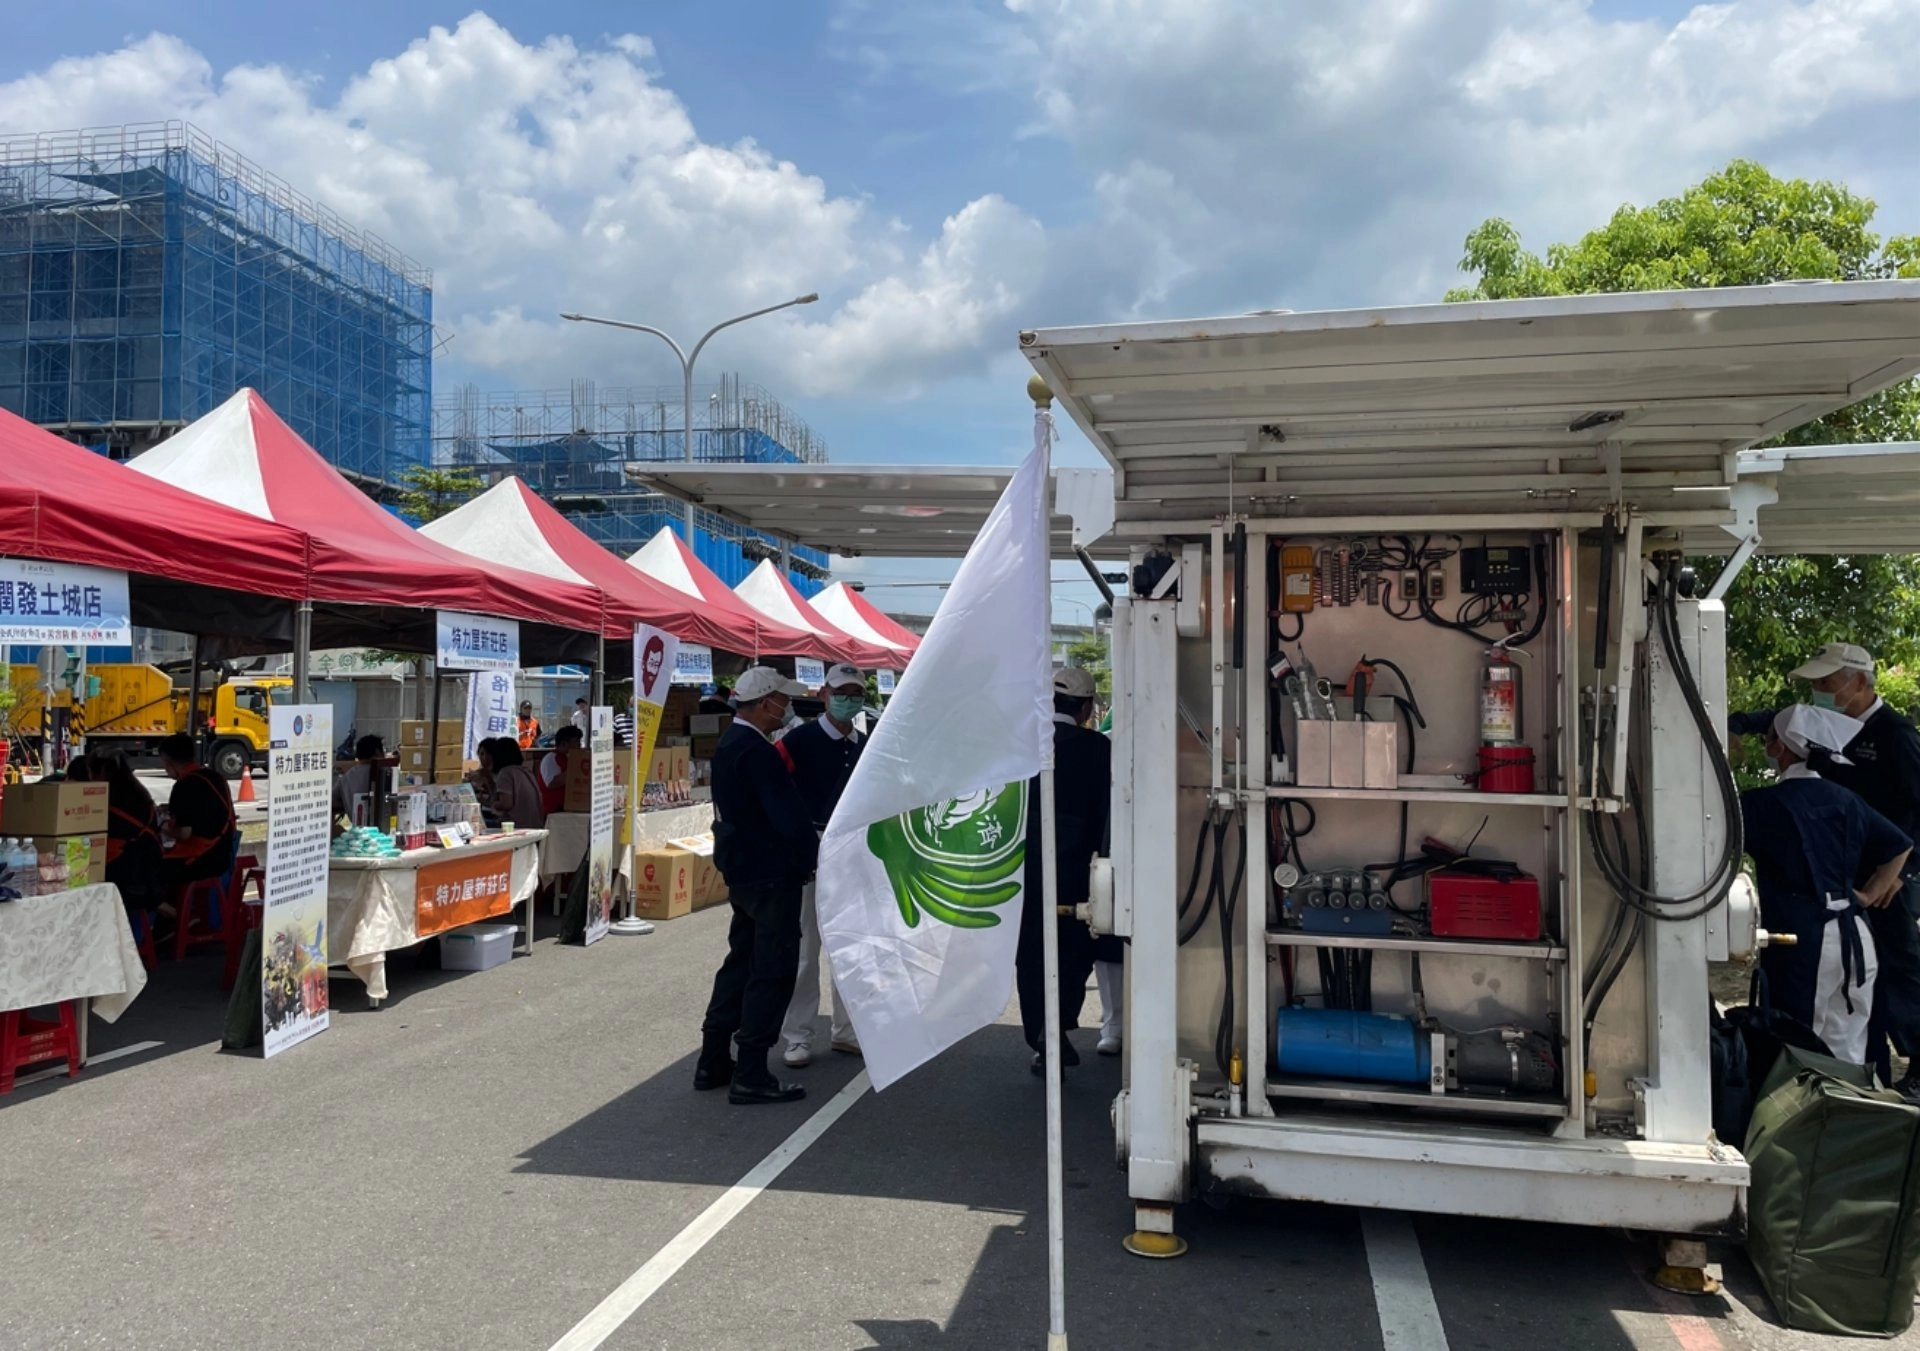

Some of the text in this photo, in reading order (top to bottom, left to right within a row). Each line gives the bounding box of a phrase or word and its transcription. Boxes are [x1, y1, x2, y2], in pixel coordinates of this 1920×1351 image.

[275, 751, 328, 775] 特力屋新莊店
[436, 872, 508, 907] 特力屋新莊店
